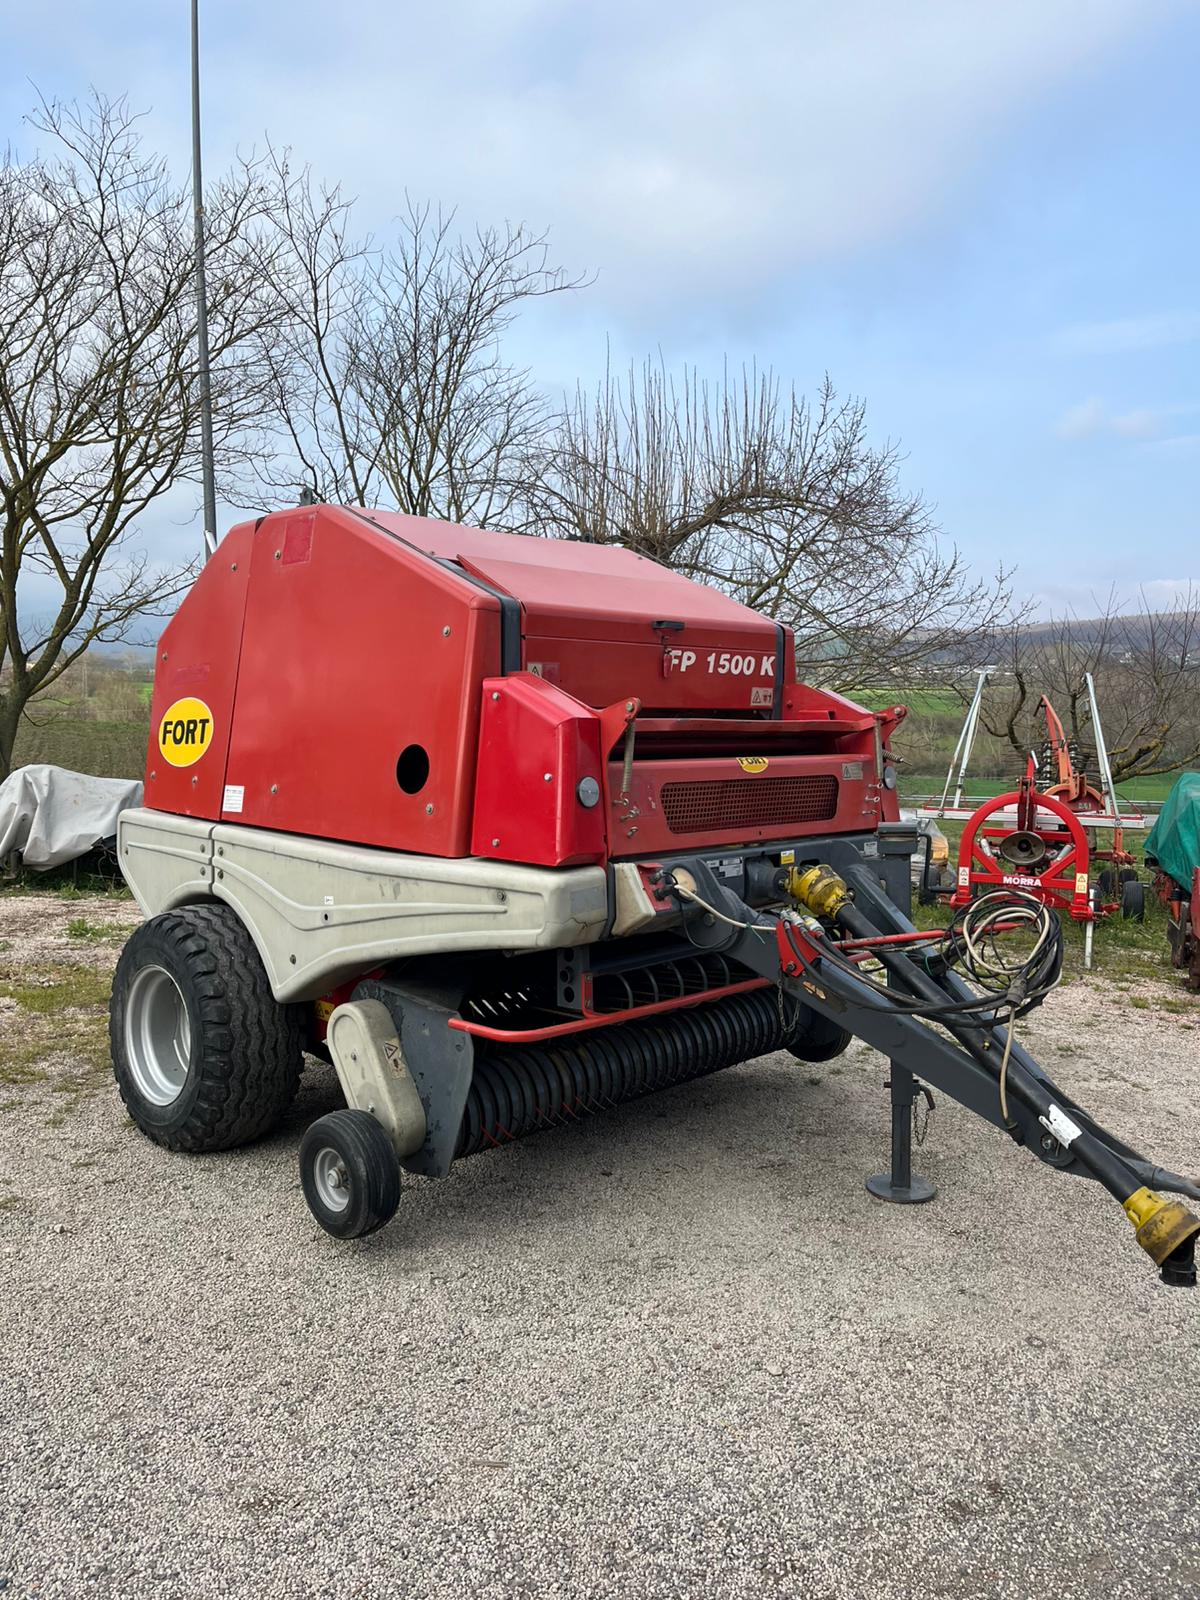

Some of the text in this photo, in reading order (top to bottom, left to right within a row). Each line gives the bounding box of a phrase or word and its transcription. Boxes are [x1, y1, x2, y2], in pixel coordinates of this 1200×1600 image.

[670, 650, 775, 676] FP 1500 K
[162, 718, 209, 745] FORT
[1002, 876, 1042, 887] MORRA
